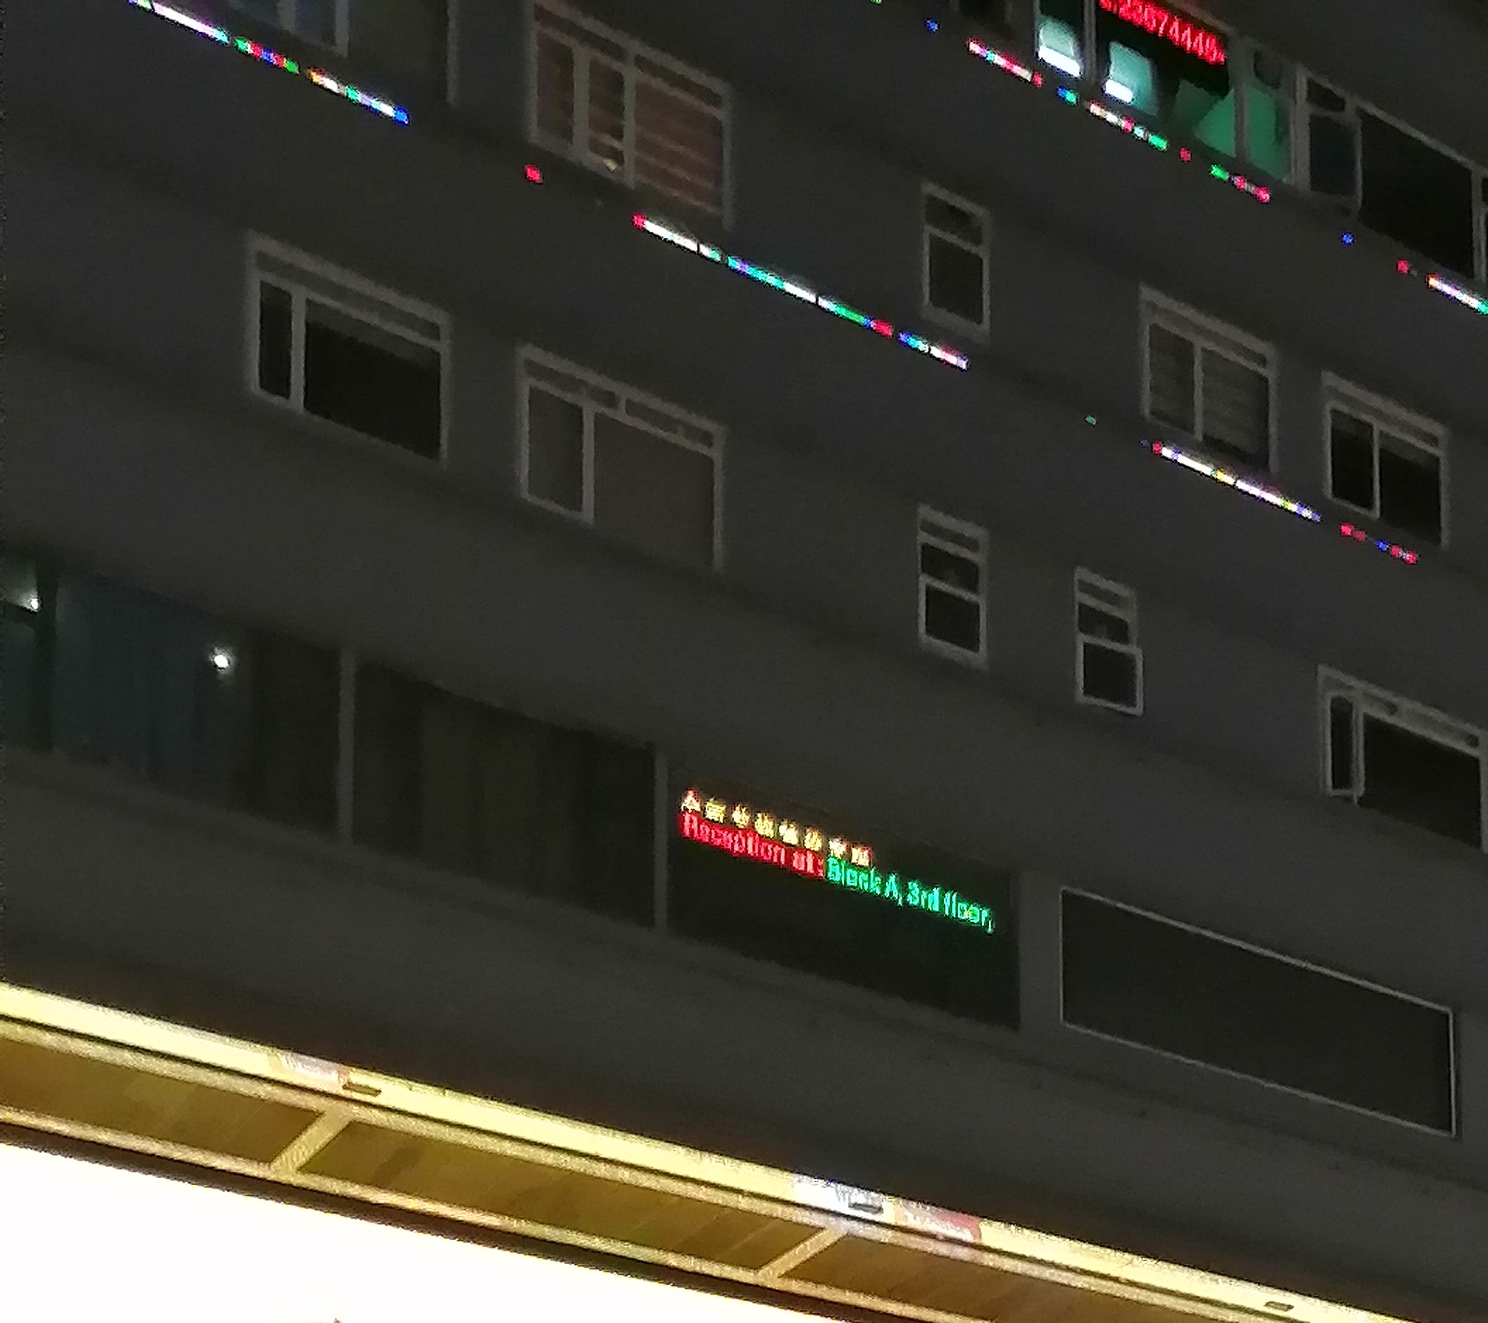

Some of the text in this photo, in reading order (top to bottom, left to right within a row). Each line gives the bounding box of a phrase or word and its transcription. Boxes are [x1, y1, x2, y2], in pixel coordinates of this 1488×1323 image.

[682, 811, 787, 867] Reception
[827, 856, 881, 895] Block
[906, 879, 940, 913] 3rd
